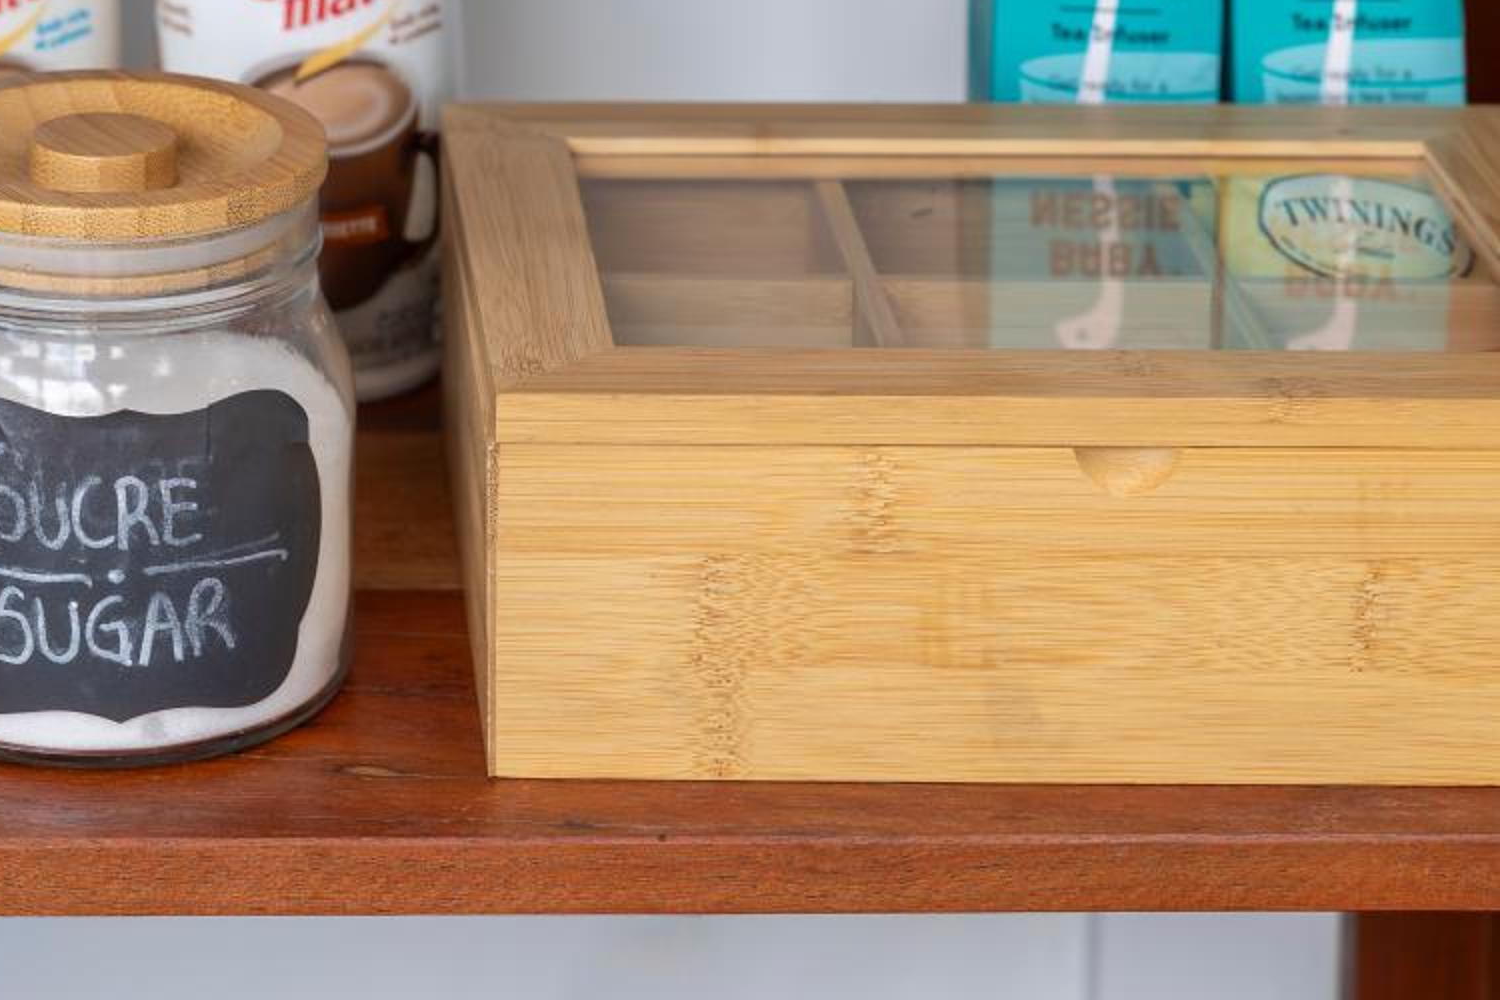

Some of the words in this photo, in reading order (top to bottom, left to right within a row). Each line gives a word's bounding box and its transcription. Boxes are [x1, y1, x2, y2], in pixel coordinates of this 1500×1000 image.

[1052, 22, 1086, 42] Tea
[1292, 13, 1326, 32] Tea
[1274, 197, 1455, 257] TWININGS
